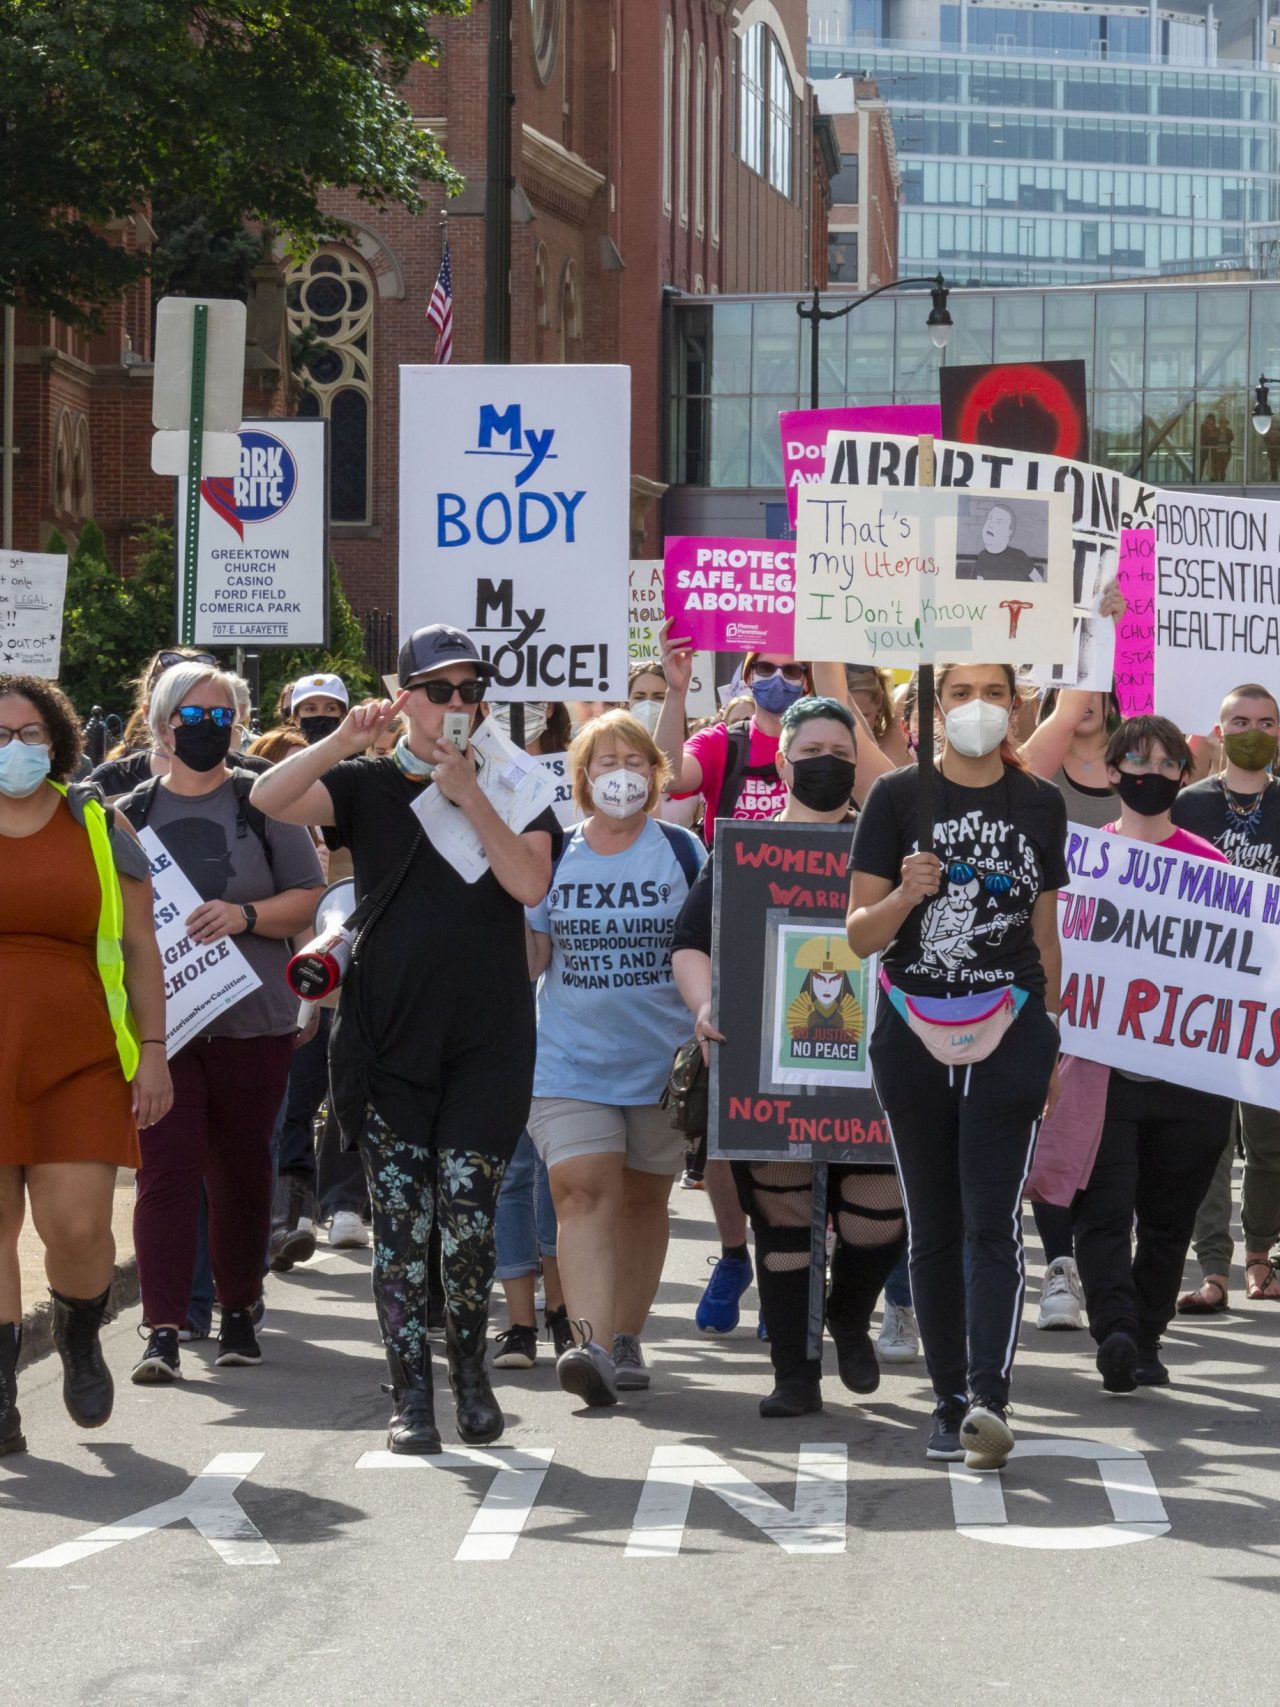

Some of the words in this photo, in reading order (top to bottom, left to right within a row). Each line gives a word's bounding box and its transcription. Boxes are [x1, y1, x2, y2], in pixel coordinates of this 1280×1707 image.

[478, 403, 556, 488] My
[240, 446, 283, 477] ARK
[233, 476, 285, 507] RITE
[437, 490, 588, 548] BODY
[806, 499, 911, 547] That's
[1156, 503, 1267, 553] ABORTION
[211, 549, 290, 560] GREEKTOWN
[224, 563, 276, 573] CHURCH
[11, 576, 33, 590] only
[227, 576, 274, 586] CASINO
[676, 570, 742, 592] SAFE,
[749, 572, 797, 592] LEG
[809, 554, 856, 590] my
[200, 602, 265, 613] COMERICA
[268, 603, 301, 613] PARK
[214, 589, 248, 599] FORD
[251, 589, 286, 599] FIELD
[684, 592, 796, 614] ABORTIO
[806, 593, 835, 620] I
[845, 597, 903, 624] Don't
[475, 577, 546, 650] My
[240, 625, 288, 634] LAFAYETTE
[482, 643, 610, 692] OICE!
[743, 779, 777, 795] EEP
[932, 810, 1014, 850] MPATHY
[735, 841, 848, 878] WOMEN
[558, 880, 660, 909] TEXAS
[768, 881, 847, 910] WARRI
[1118, 847, 1178, 895] JUST
[1178, 860, 1255, 919] WANNA
[606, 919, 619, 935] A
[623, 918, 674, 934] VIRUS
[574, 937, 673, 951] REPRODUCTIVE
[620, 951, 656, 969] AND
[613, 970, 672, 988] DOESN'T
[960, 969, 1015, 984] FINGER
[166, 973, 248, 1040] ratoriumNowCoalition
[792, 1041, 811, 1057] NO
[814, 1042, 858, 1060] PEACE
[728, 1096, 792, 1125] NOT
